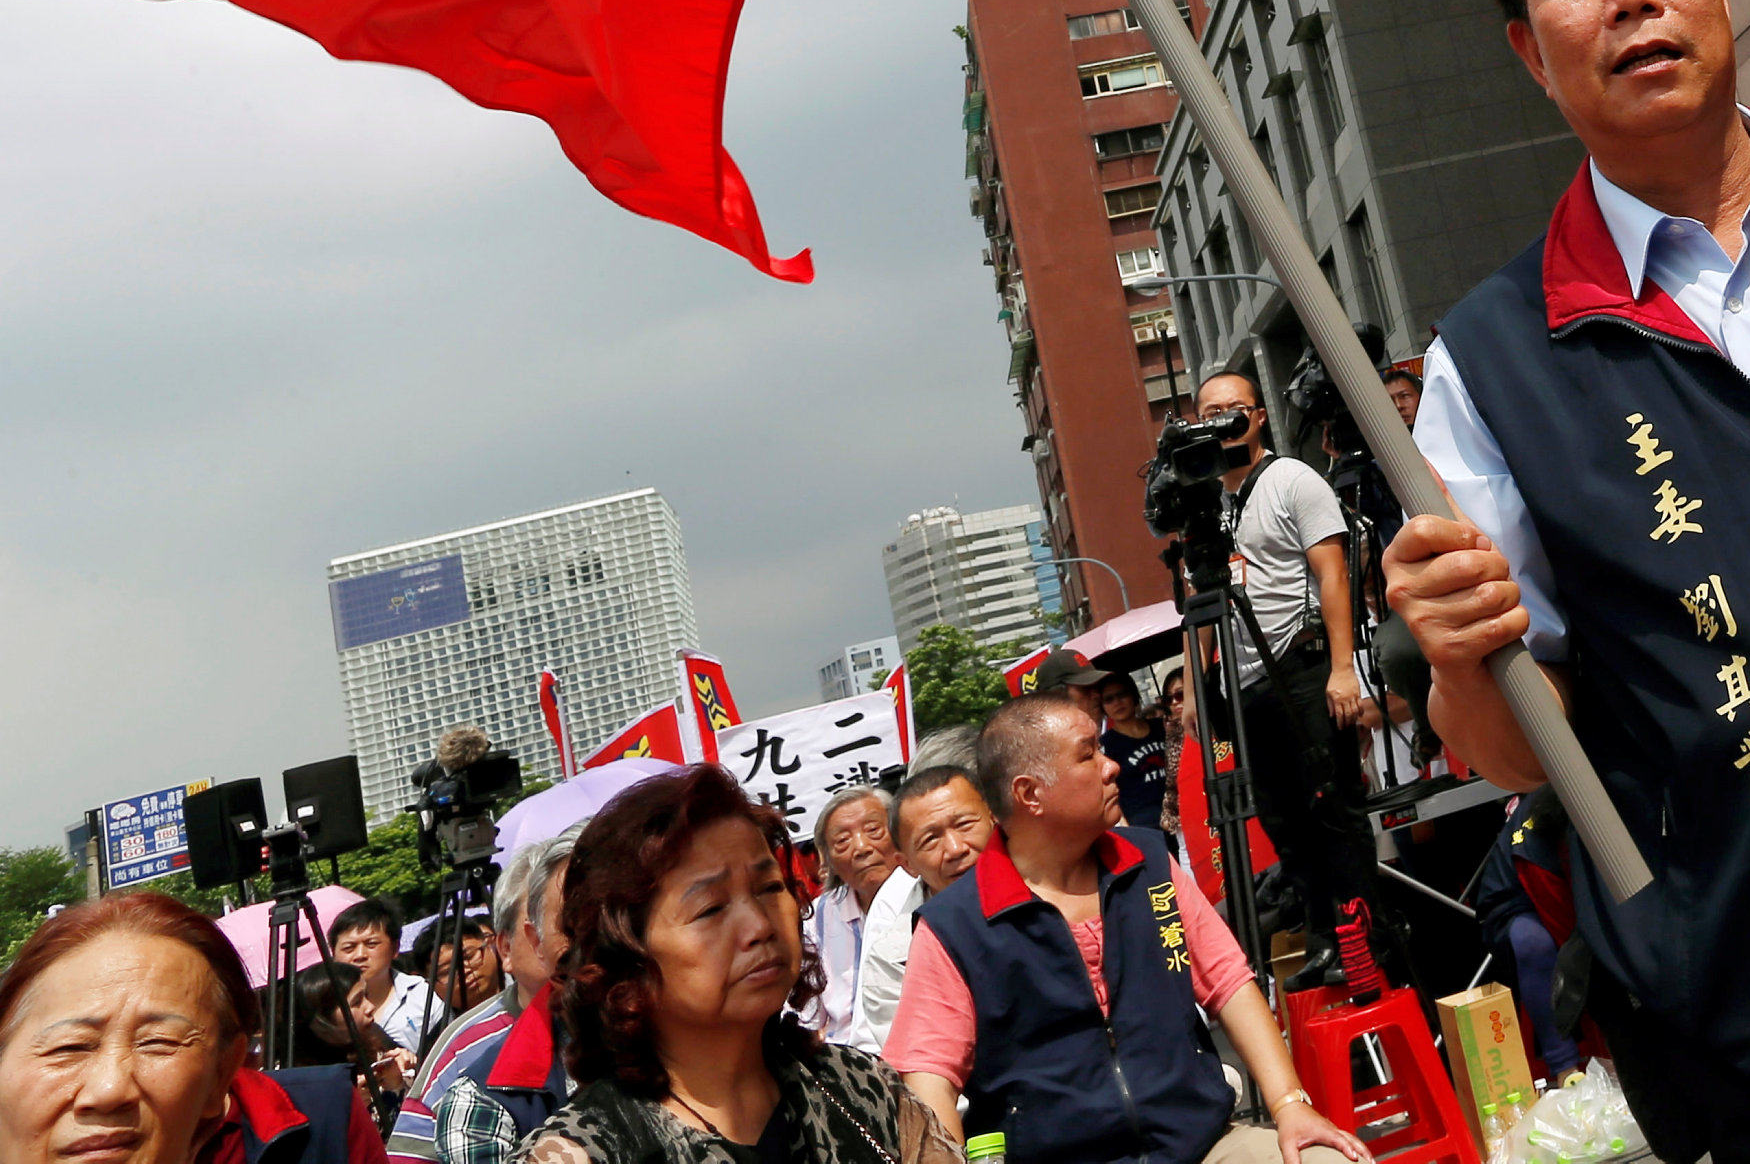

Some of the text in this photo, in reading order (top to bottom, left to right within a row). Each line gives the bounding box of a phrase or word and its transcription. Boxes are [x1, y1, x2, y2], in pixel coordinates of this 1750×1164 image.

[1625, 412, 1703, 544] 主委
[122, 837, 144, 848] 30
[123, 847, 144, 858] 60
[114, 860, 169, 883] 尚有車位
[1159, 921, 1191, 973] 蒼水
